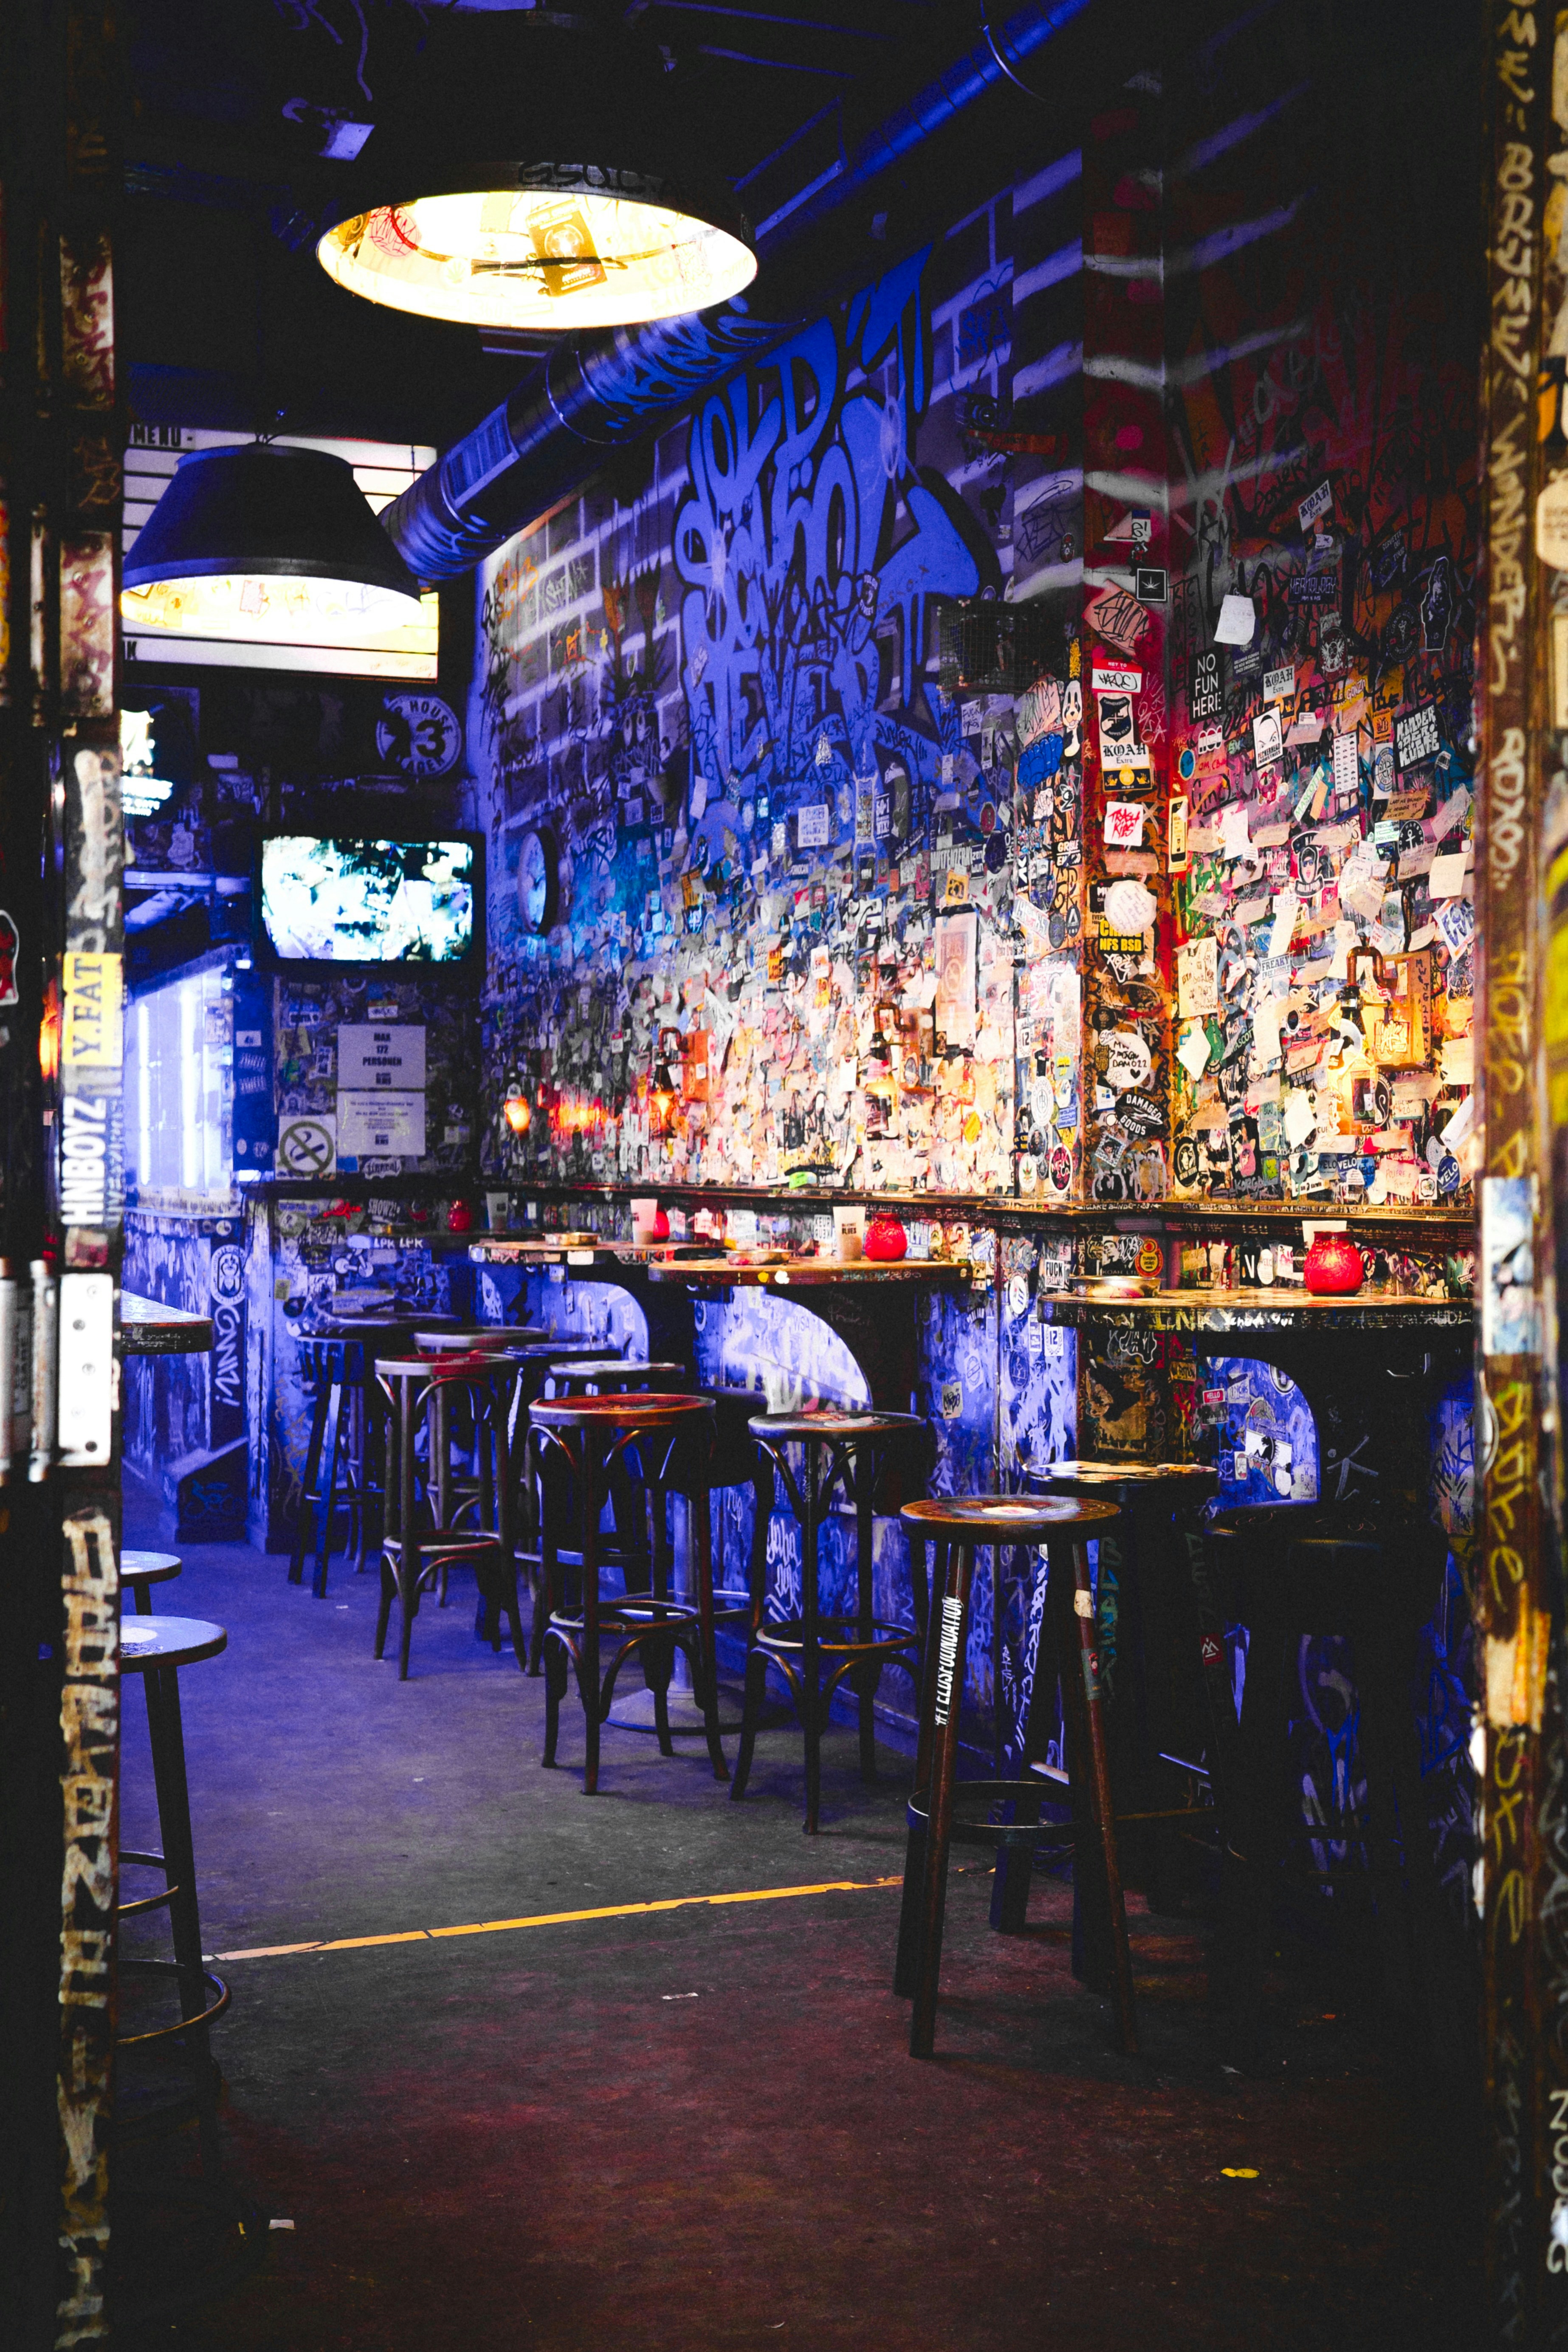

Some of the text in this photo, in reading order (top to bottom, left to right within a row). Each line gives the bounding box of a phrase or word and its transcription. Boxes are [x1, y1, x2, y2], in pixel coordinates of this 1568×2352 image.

[133, 425, 181, 446] MENU
[1197, 654, 1215, 675] NO
[1195, 672, 1218, 697] FUN
[1265, 672, 1294, 688] KOAH
[1396, 705, 1437, 741] KINDER
[1103, 744, 1146, 757] KOAH
[1258, 743, 1281, 759] PECKERHEAD
[1258, 750, 1281, 764] INDUSTRIES
[1107, 808, 1141, 823] TRASH
[1111, 821, 1135, 841] KIDS
[1376, 834, 1399, 842] PRIVACY
[1100, 938, 1142, 951] NFS BSD
[1262, 956, 1290, 972] FREAKY
[73, 957, 103, 1057] Y.FAT
[1021, 1032, 1029, 1046] 12
[1126, 1094, 1162, 1120] DAMAGED
[1120, 1114, 1147, 1135] GOODS
[1338, 1159, 1357, 1169] VELO
[1438, 1162, 1458, 1185] VELO
[1046, 1261, 1063, 1276] FUCK
[1049, 1330, 1058, 1345] 12
[1206, 1390, 1221, 1399] HELLO
